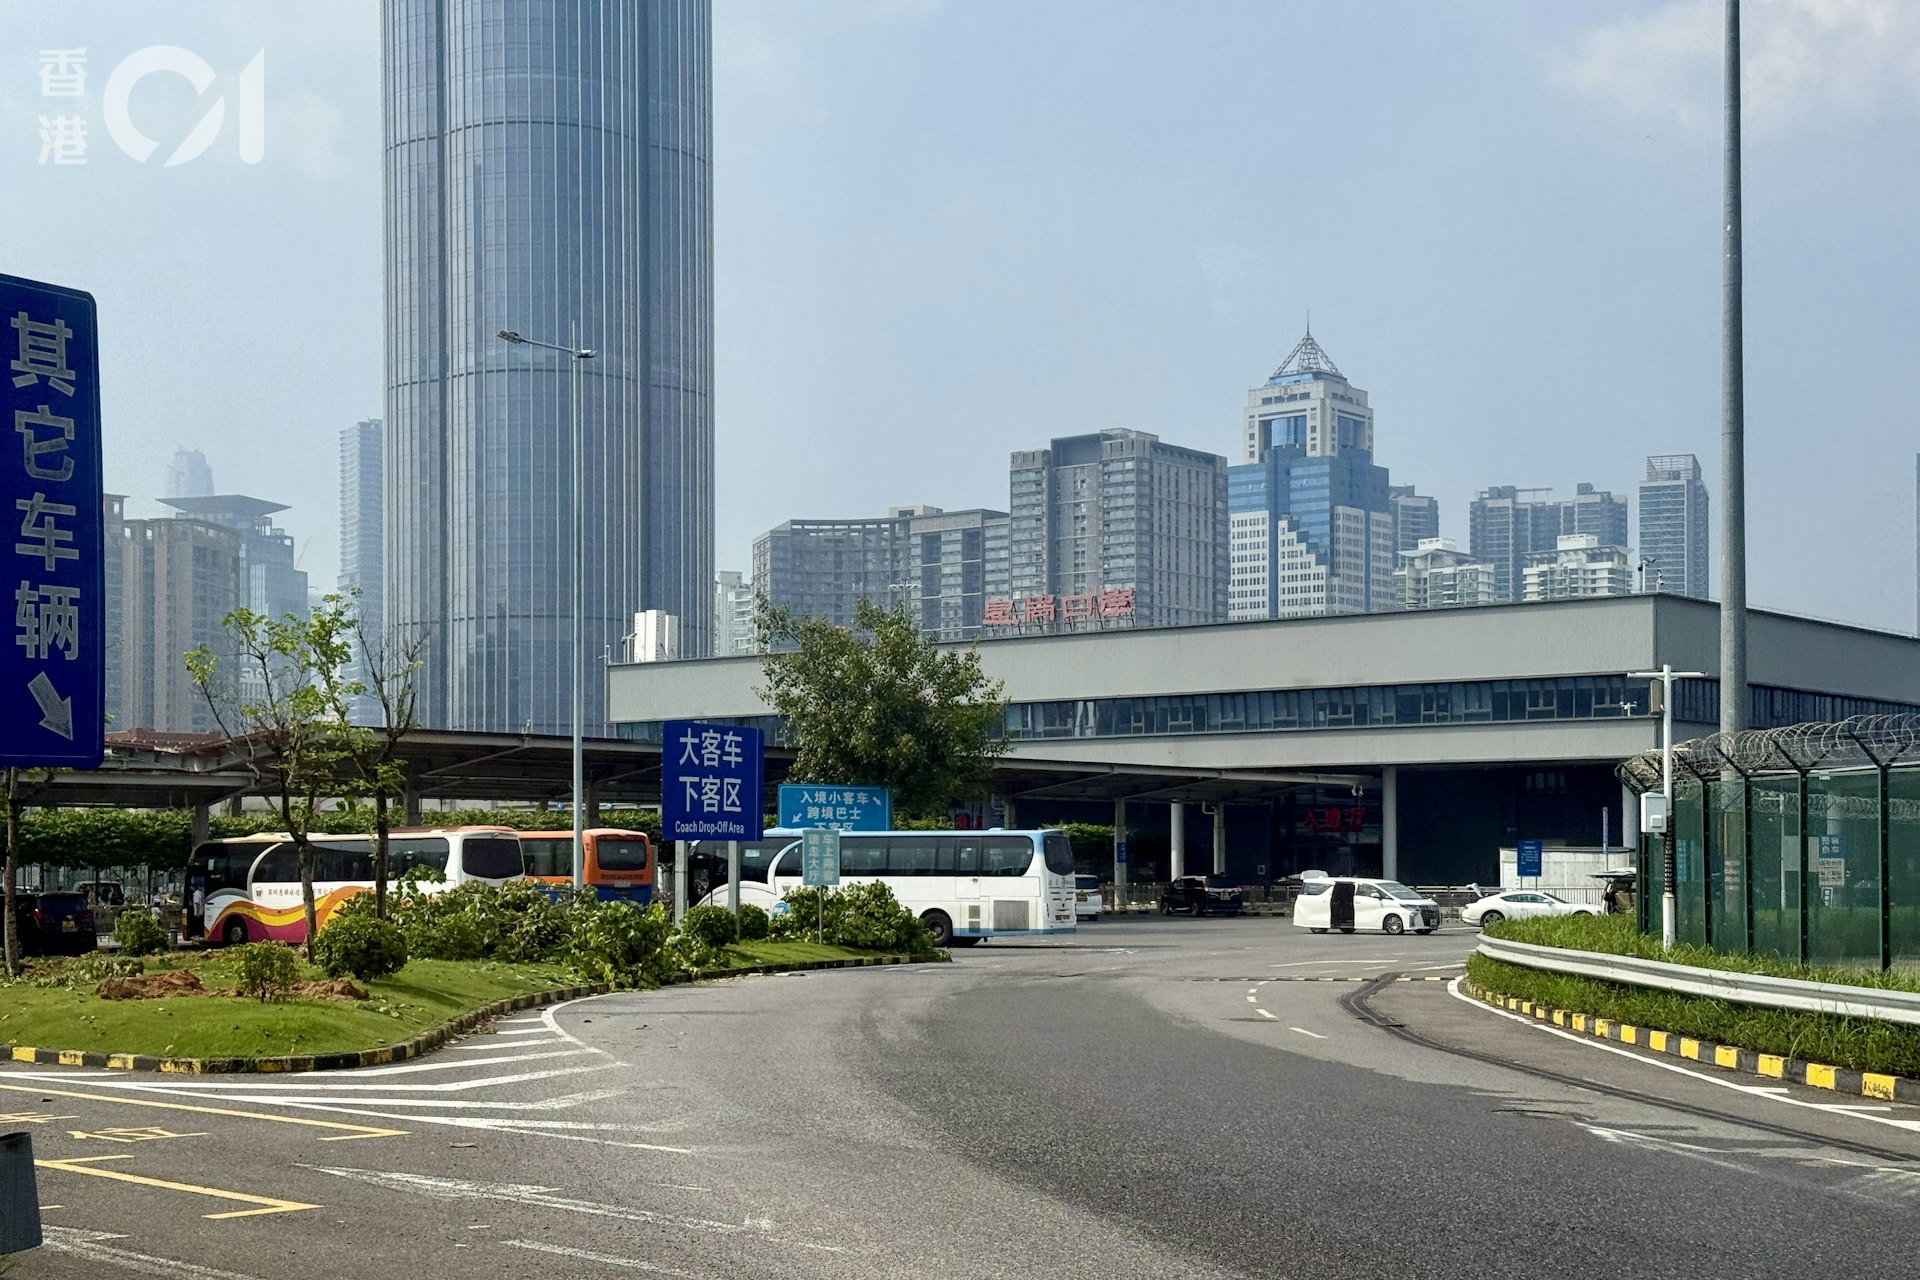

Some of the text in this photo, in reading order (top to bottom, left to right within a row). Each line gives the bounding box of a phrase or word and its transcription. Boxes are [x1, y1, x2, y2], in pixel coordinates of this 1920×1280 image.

[10, 311, 81, 662] 其它车辆
[679, 727, 742, 769] 大客车
[679, 774, 742, 814] 下客区
[800, 790, 869, 805] 入境小客车
[807, 806, 862, 820] 跨境巴士
[675, 820, 745, 836] Coach Drop-Off Area
